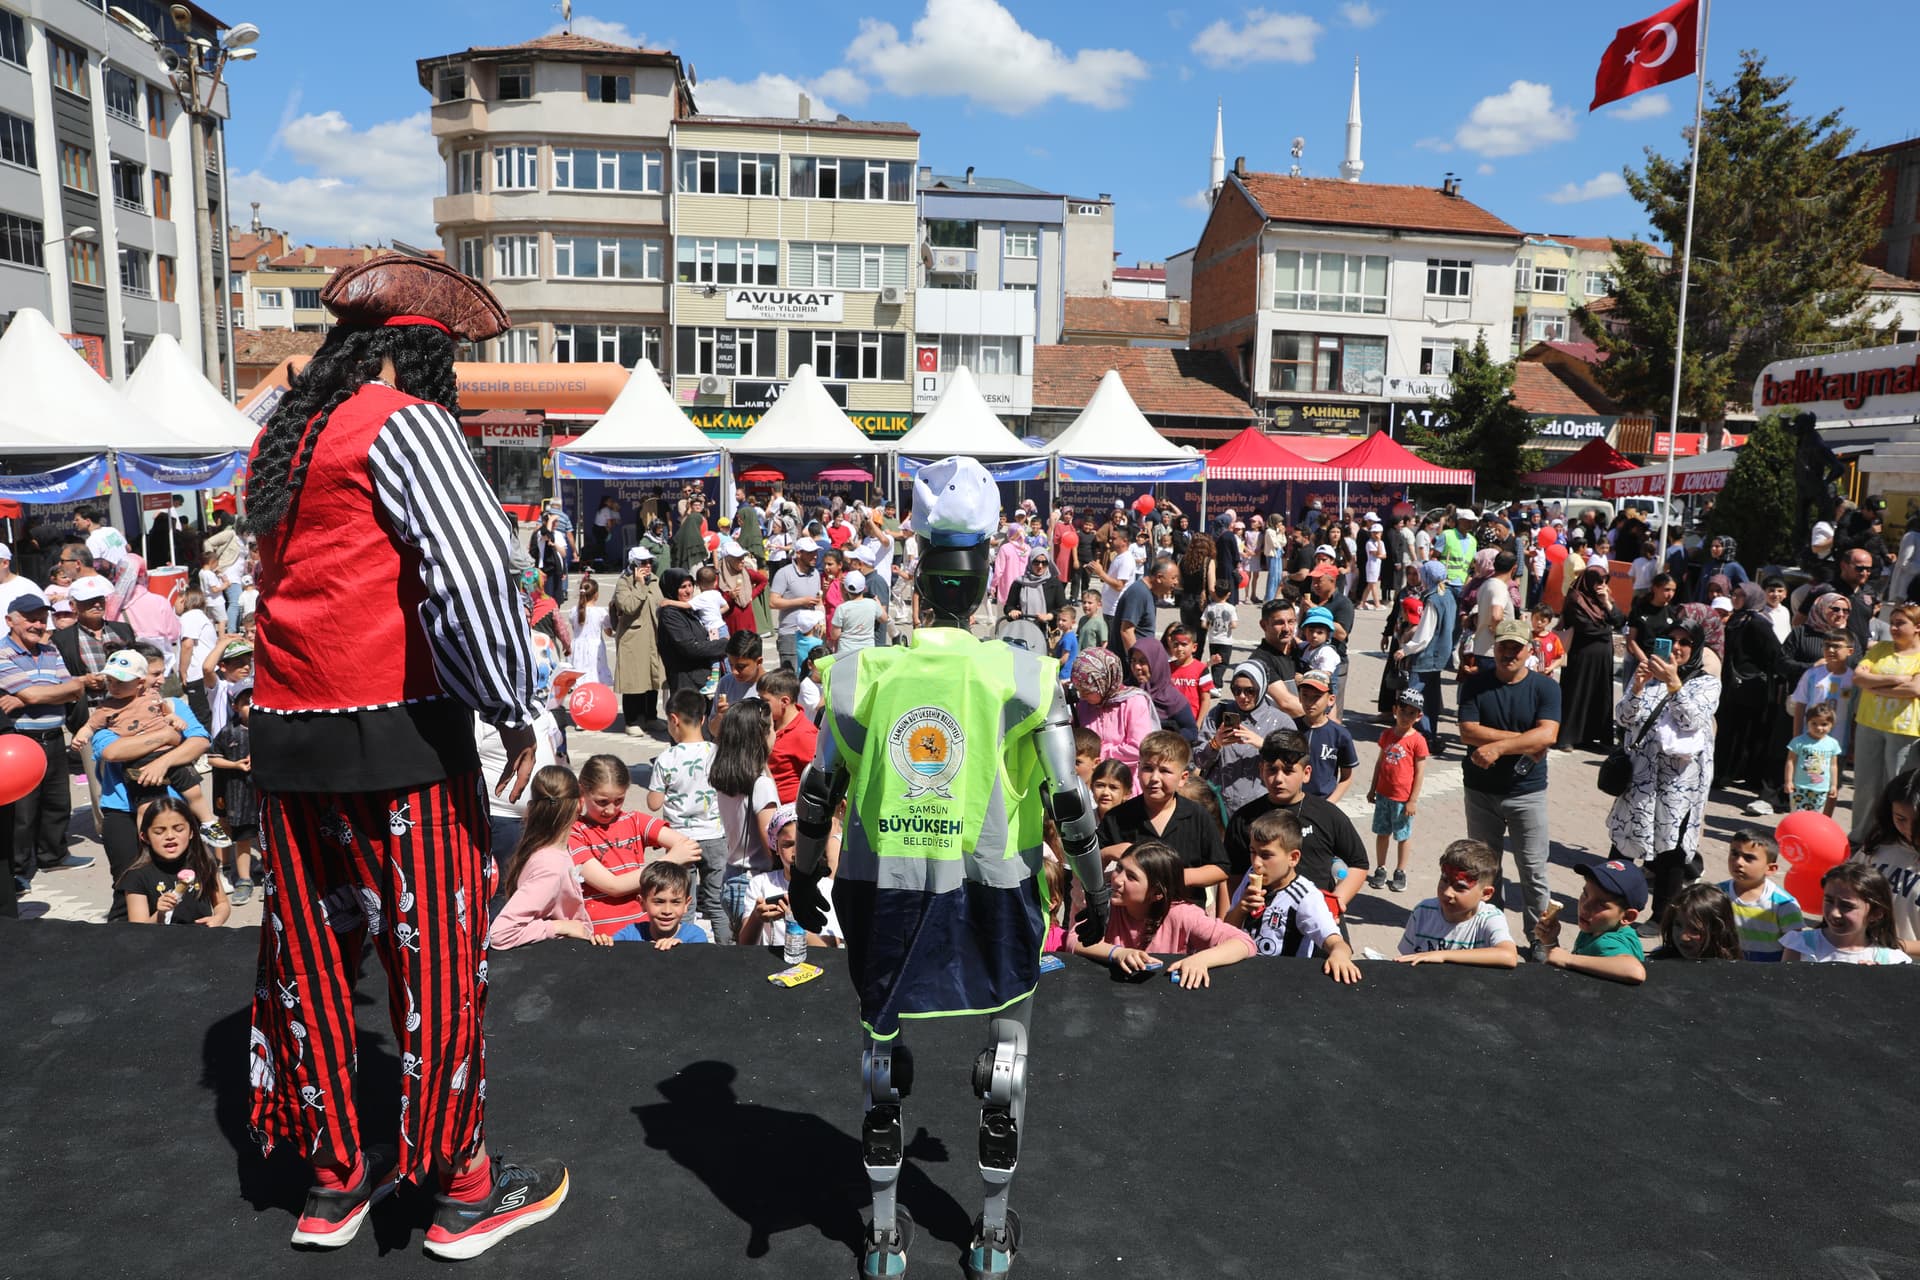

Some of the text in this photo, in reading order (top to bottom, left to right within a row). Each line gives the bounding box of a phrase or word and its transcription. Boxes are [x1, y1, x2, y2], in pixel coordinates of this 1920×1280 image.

[736, 291, 834, 306] AVUKAT
[752, 304, 818, 313] Metin YILDIRIM
[513, 379, 587, 392] BELEDİYESİ
[1302, 404, 1360, 419] ŞAHİNLER
[688, 414, 725, 428] ALK
[484, 424, 539, 437] ECZANE
[1563, 420, 1606, 439] Optik
[893, 719, 909, 741] SAMSUN
[909, 805, 948, 814] SAMSUN
[903, 833, 953, 848] BELEDİYESİ
